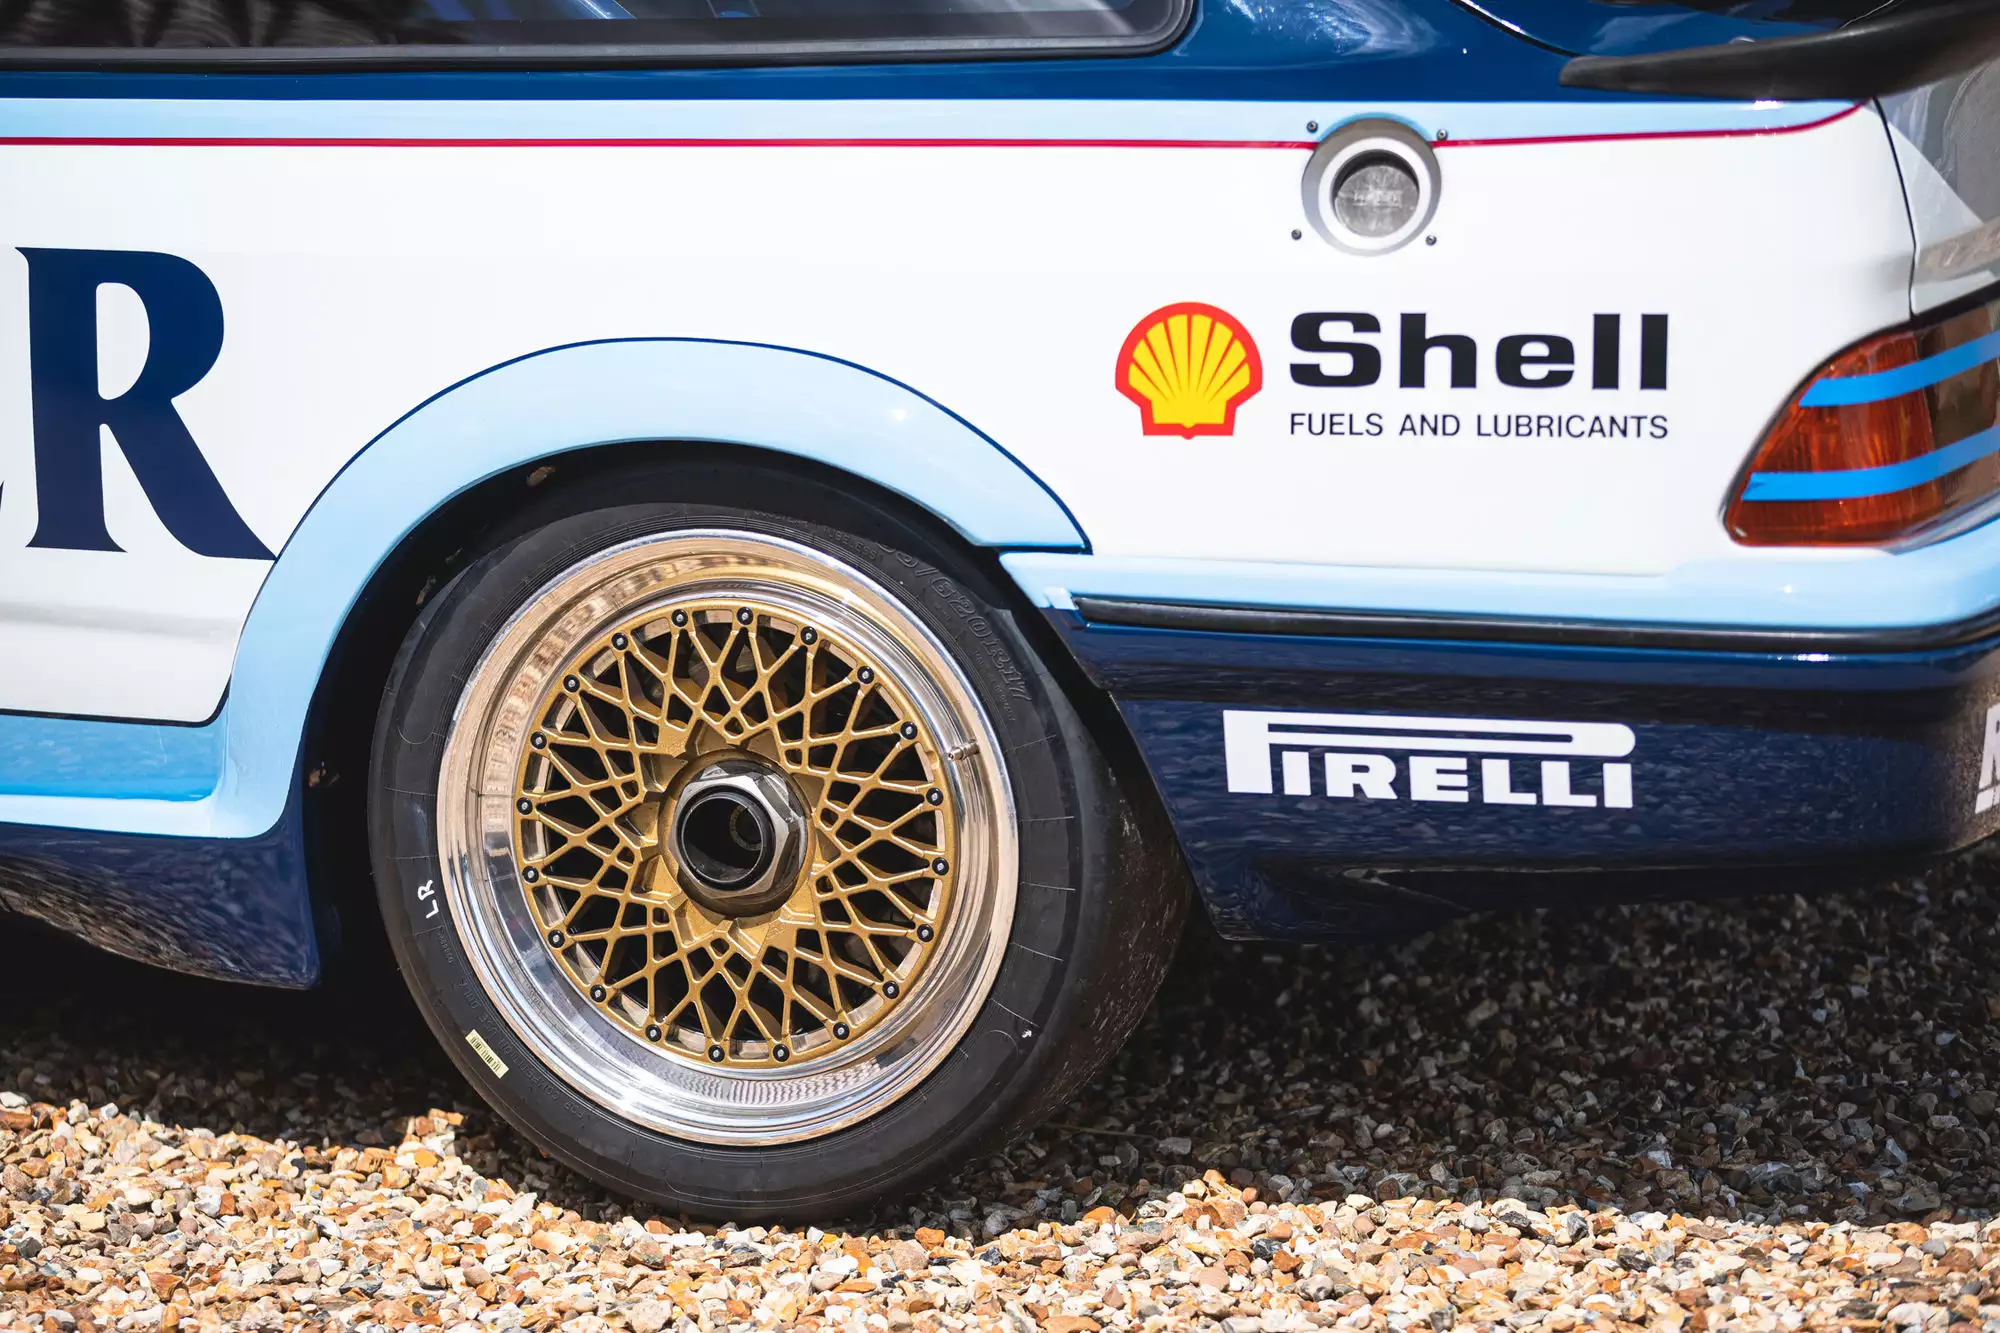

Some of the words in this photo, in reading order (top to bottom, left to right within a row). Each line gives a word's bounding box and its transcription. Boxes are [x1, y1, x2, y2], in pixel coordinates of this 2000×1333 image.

[1290, 312, 1668, 390] Shell
[0, 247, 276, 560] R
[1291, 413, 1383, 436] FUELS
[1399, 414, 1461, 436] AND
[1477, 414, 1668, 439] LUBRICANTS
[1223, 710, 1635, 808] PIRELLI
[417, 879, 440, 919] LR
